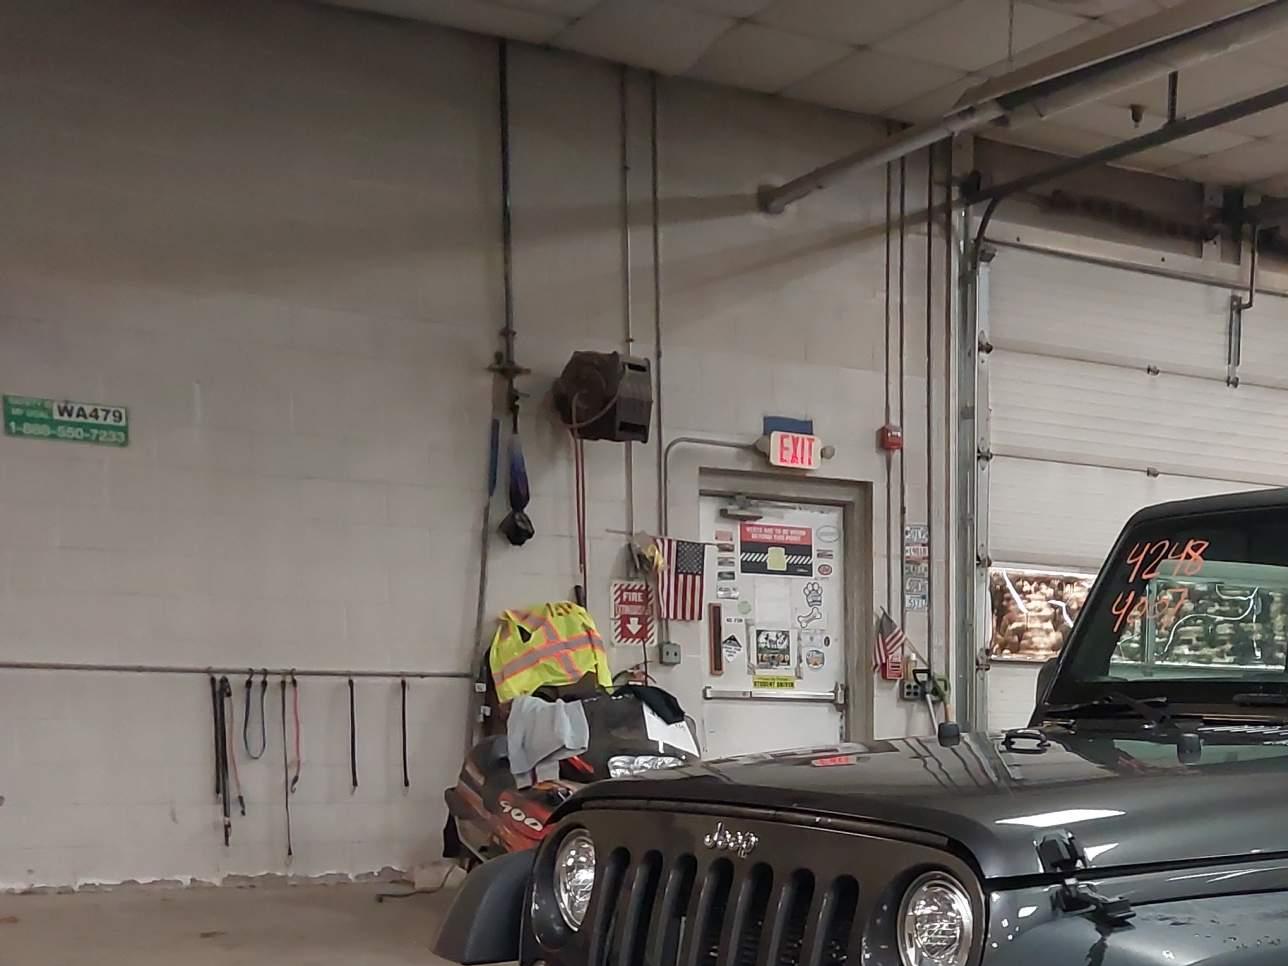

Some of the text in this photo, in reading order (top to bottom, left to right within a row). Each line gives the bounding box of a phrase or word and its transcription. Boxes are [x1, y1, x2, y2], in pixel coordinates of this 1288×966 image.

[57, 404, 123, 423] WA479
[779, 433, 815, 465] EXIT
[1127, 539, 1209, 583] 4248
